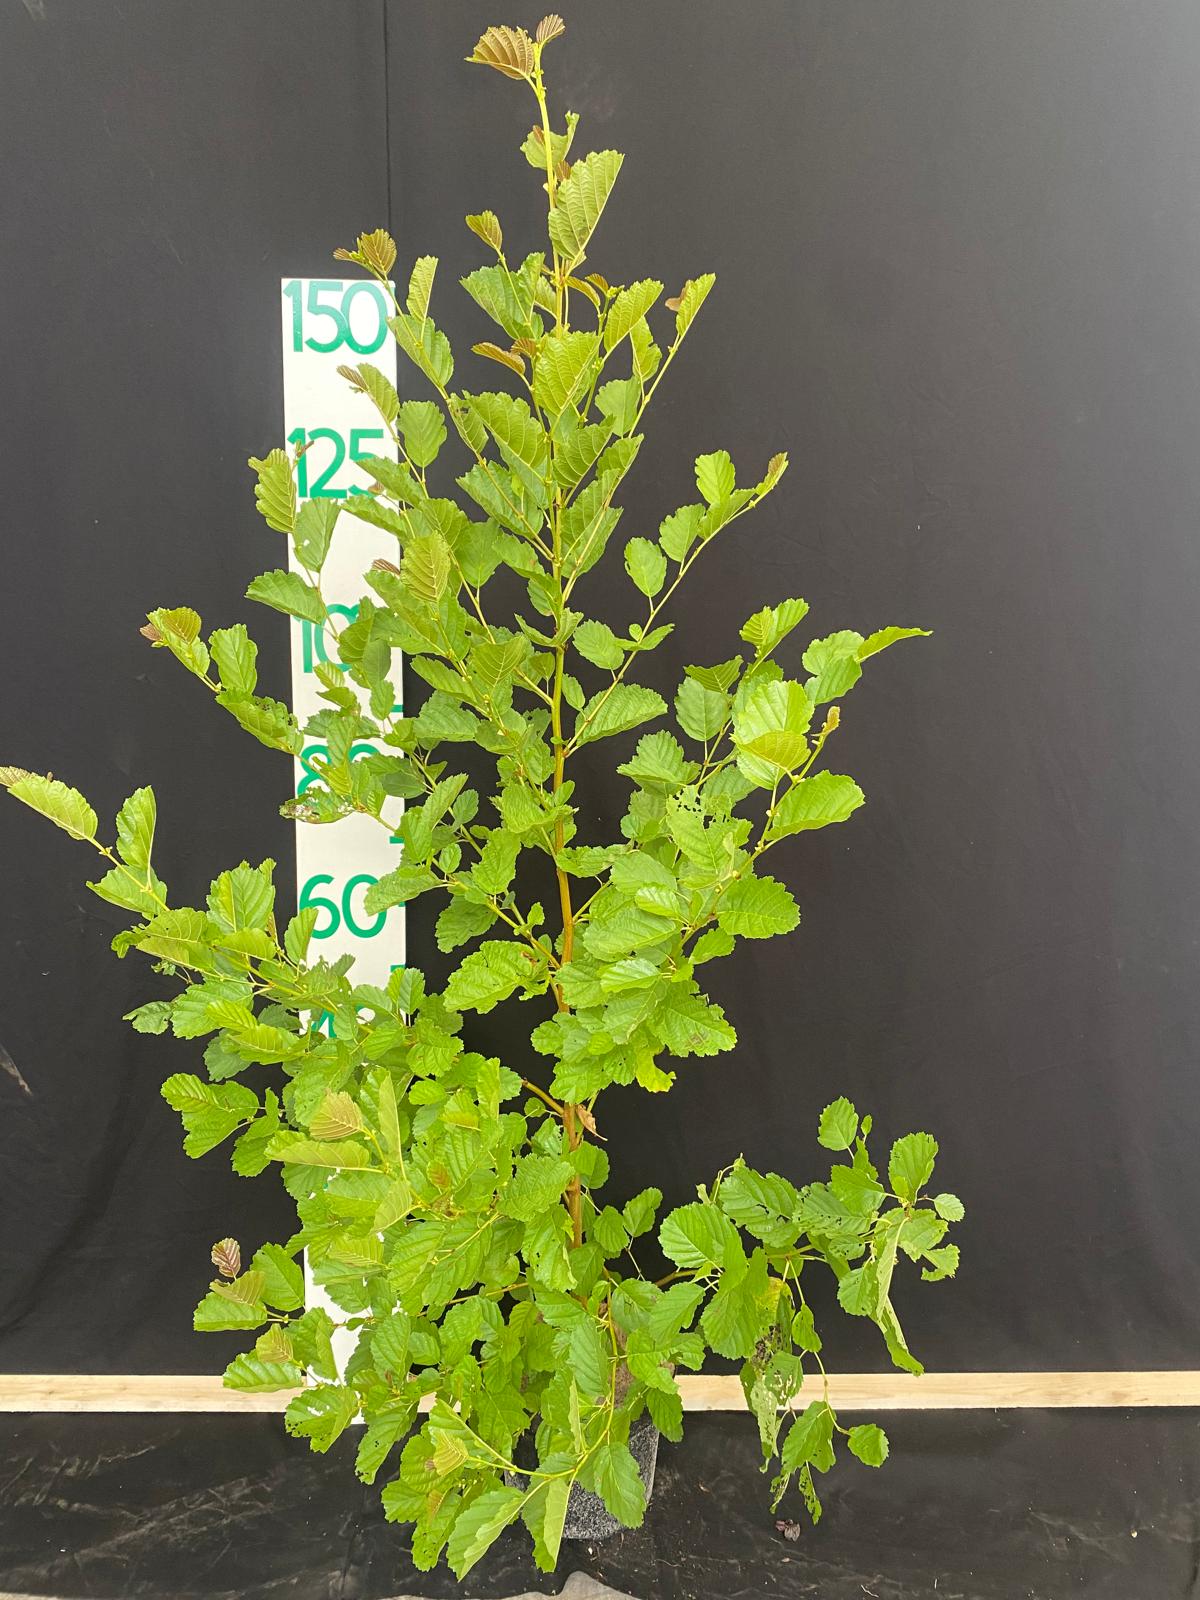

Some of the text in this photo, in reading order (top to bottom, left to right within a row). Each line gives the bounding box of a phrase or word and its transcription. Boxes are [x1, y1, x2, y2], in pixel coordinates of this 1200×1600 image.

[283, 280, 389, 355] 150
[287, 427, 384, 499] 125
[293, 603, 361, 673] 10
[299, 874, 388, 939] 60
